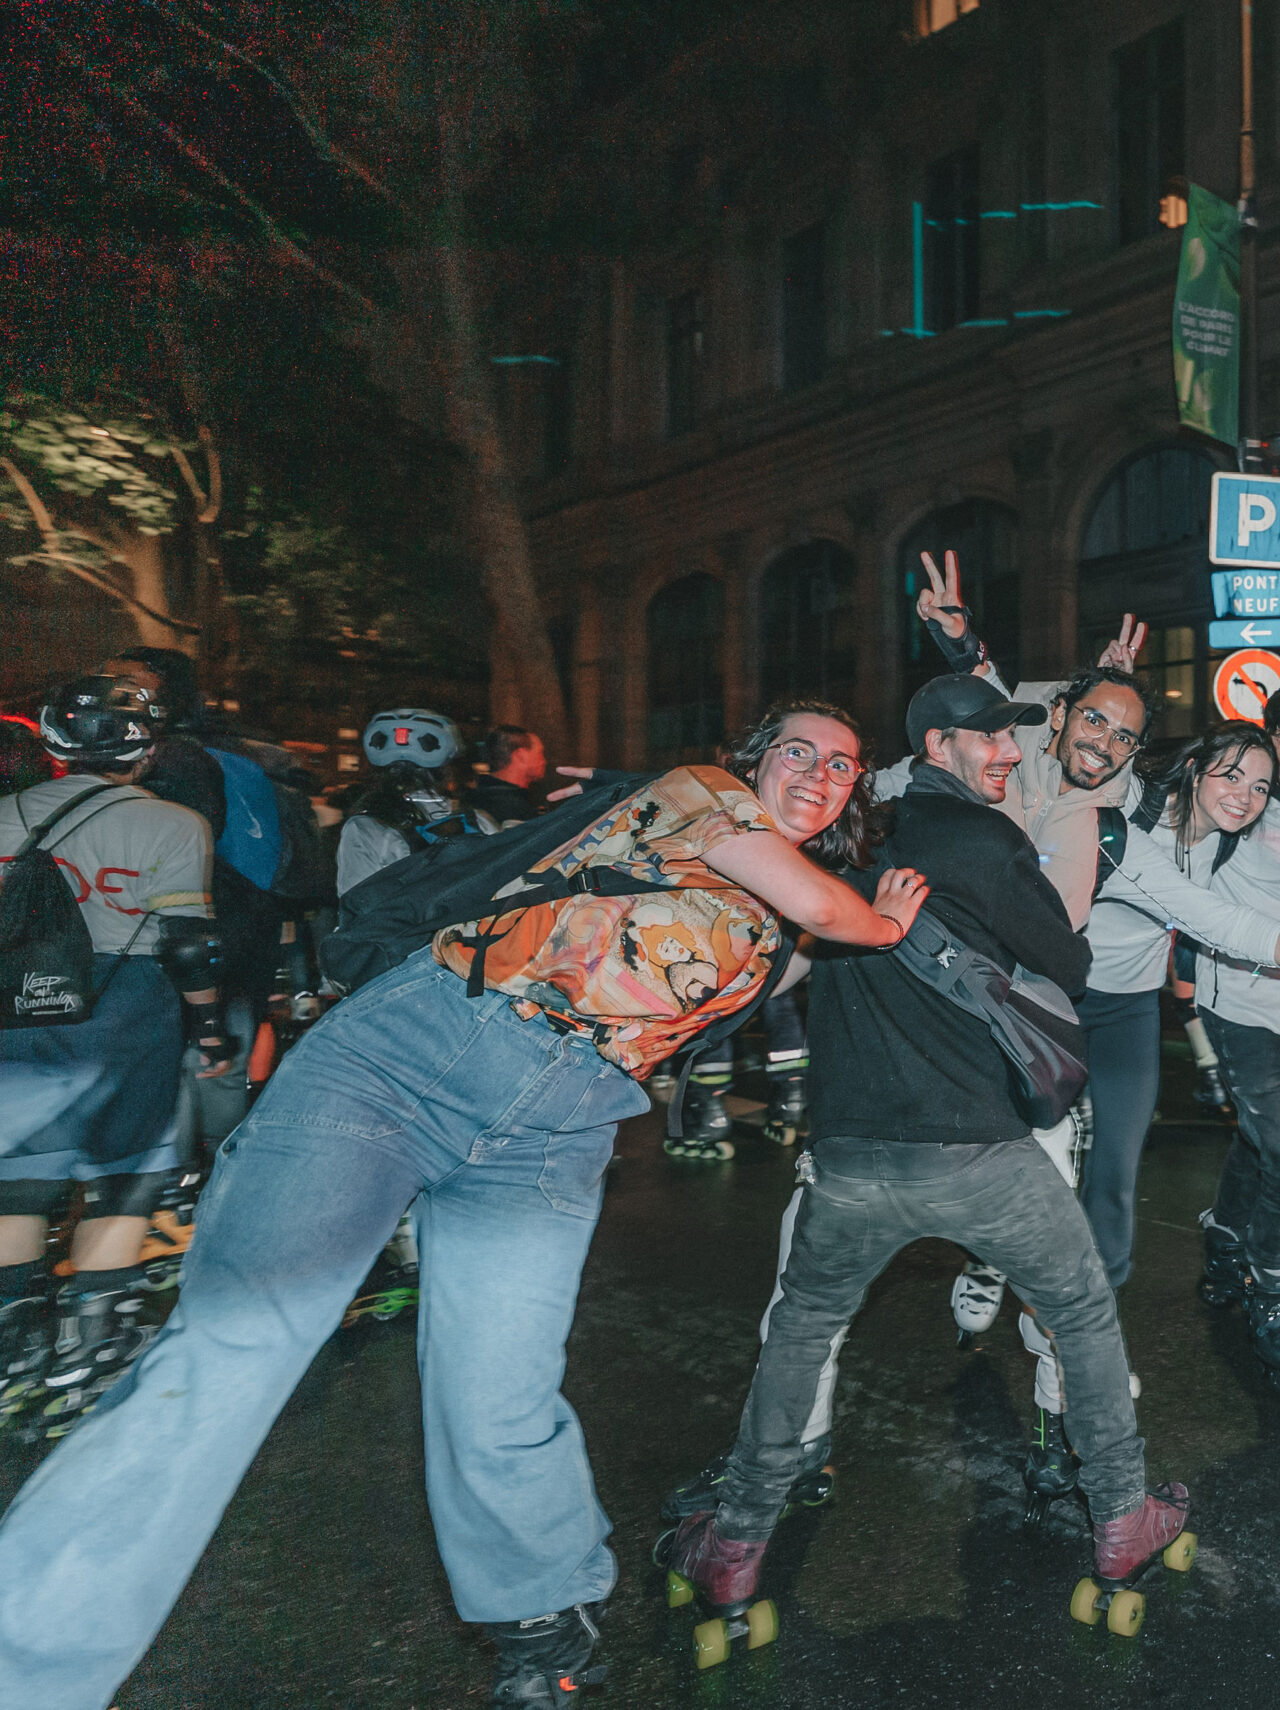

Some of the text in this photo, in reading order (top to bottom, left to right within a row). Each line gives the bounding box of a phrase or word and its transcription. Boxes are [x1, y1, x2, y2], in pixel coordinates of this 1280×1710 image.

[1178, 301, 1235, 322] L'ACCORD
[1180, 314, 1233, 334] DE PARIS
[1182, 328, 1232, 346] POUR LE
[1186, 341, 1228, 357] CLIMAT
[1237, 493, 1277, 547] P
[1232, 575, 1279, 591] PONT
[1232, 597, 1280, 613] NEUF
[23, 971, 63, 996] KEEP
